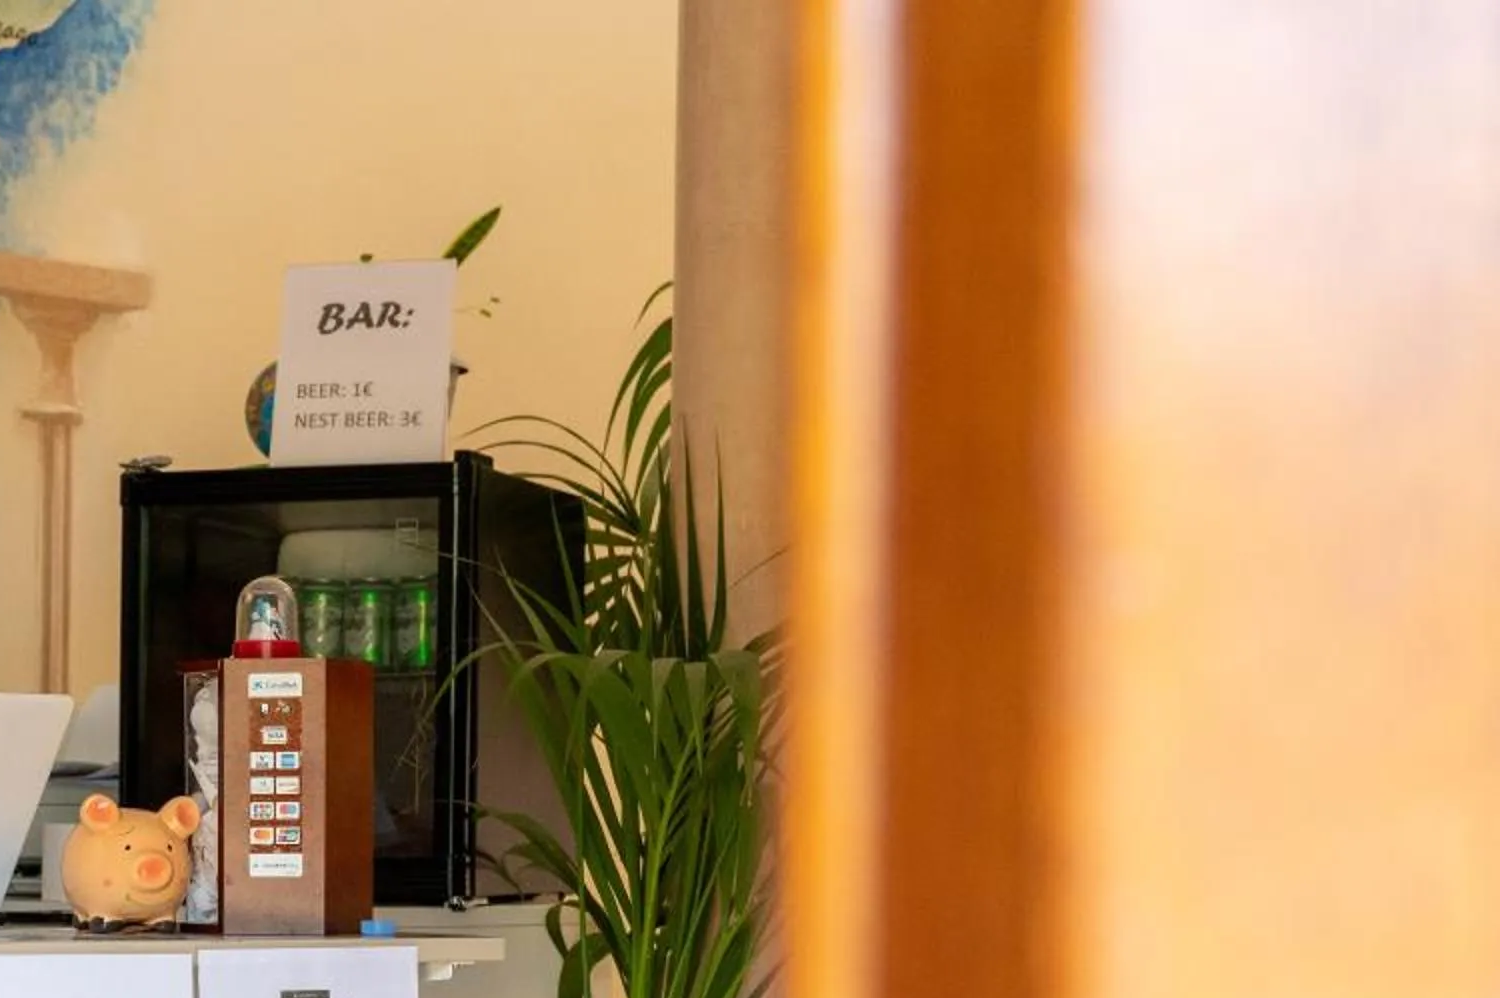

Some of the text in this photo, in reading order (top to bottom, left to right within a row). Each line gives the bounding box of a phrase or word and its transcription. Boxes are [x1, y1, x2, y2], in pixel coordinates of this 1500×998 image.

[317, 301, 414, 335] BAR:
[297, 381, 375, 399] BEER: 1€
[294, 411, 422, 429] NEST BEER: 3€
